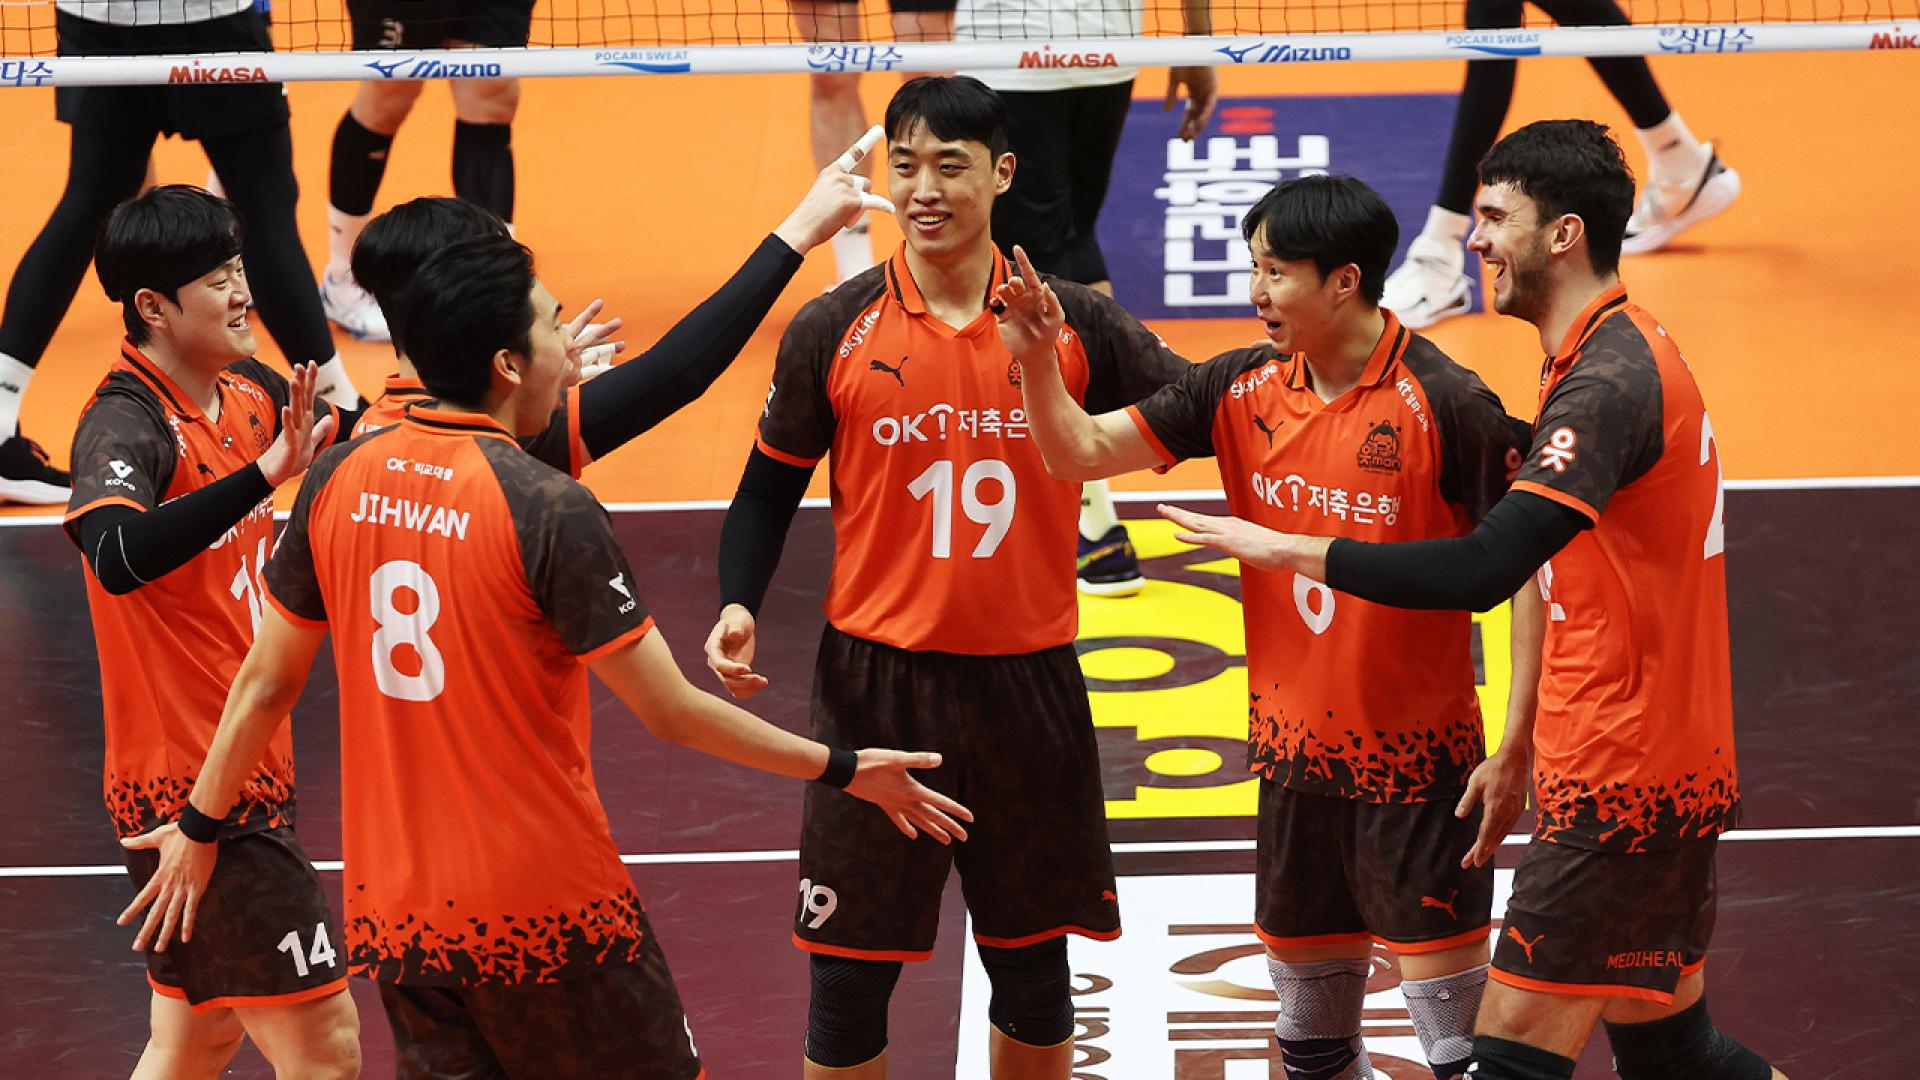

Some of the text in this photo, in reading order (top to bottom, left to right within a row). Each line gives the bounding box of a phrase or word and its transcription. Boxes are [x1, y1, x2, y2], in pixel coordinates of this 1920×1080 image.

[595, 50, 688, 61] POCARI SWEAT
[1446, 33, 1540, 45] POCARI SWEAT
[0, 61, 54, 86] 다수
[958, 407, 1029, 439] 저축은
[350, 491, 471, 541] JIHWAN
[907, 459, 1017, 559] 19
[370, 559, 445, 702] 8
[799, 878, 838, 929] 19
[276, 921, 337, 977] 14
[1606, 950, 1684, 969] MEDIHEAL
